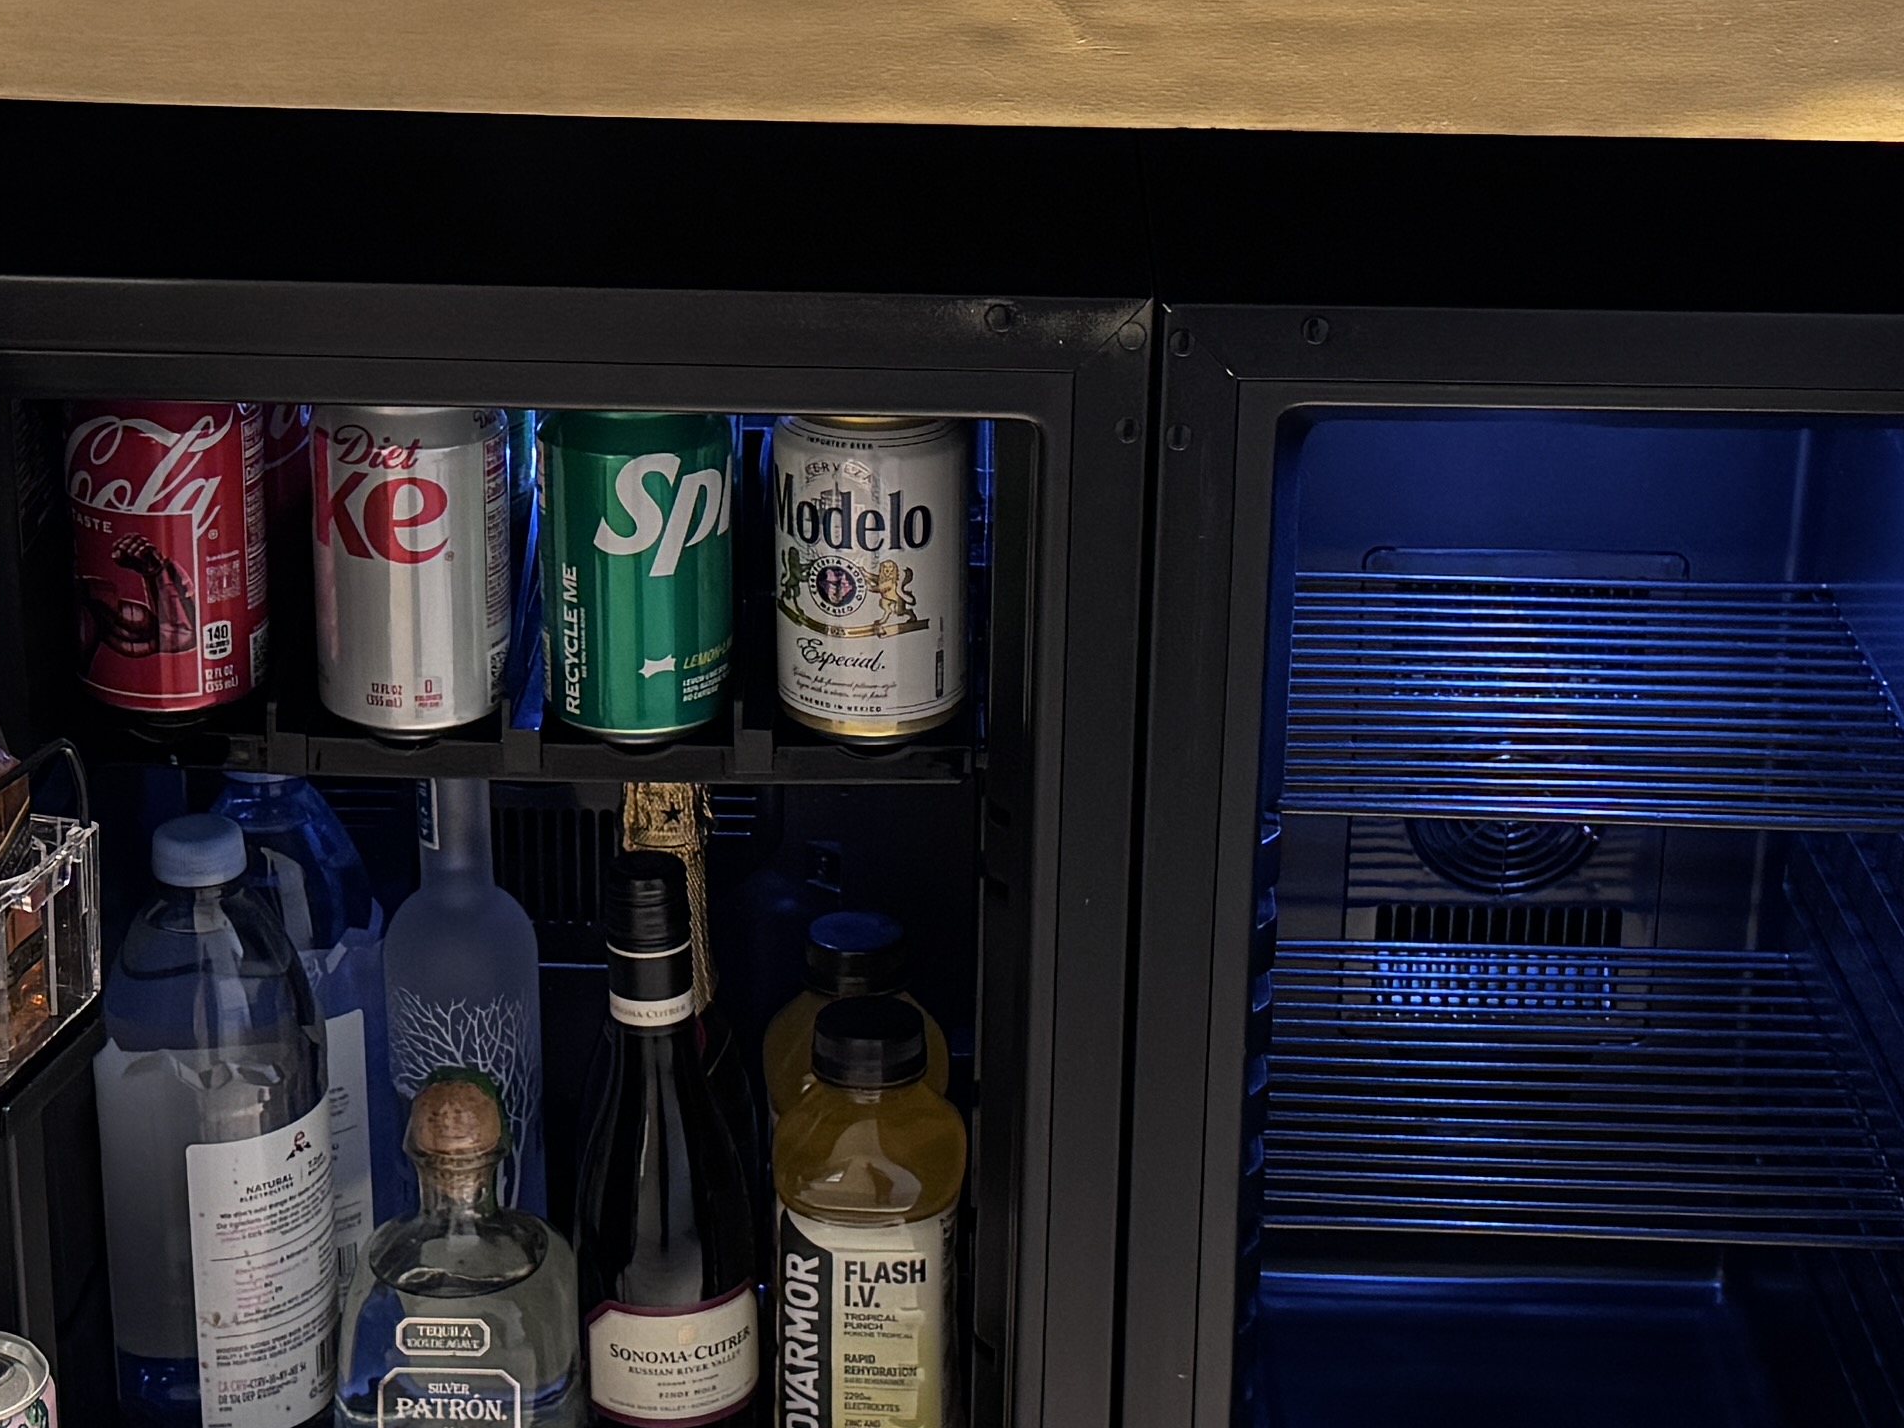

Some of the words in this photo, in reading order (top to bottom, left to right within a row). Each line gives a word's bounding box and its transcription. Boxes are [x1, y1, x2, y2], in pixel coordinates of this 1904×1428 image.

[334, 424, 422, 470] Diet
[775, 464, 933, 552] Modelo
[562, 562, 578, 604] ME
[207, 624, 229, 642] 140
[564, 605, 581, 715] RECYCLE
[246, 1173, 294, 1194] NATURAL
[844, 1259, 926, 1283] FLASH
[844, 1285, 881, 1308] I.V.
[844, 1313, 899, 1323] TROPICAL
[844, 1322, 883, 1331] PUNCH
[844, 1354, 876, 1363] RAPID
[628, 1365, 673, 1376] RUSSIAN
[677, 1363, 709, 1375] RIVER
[844, 1365, 918, 1377] REHYDRATION
[427, 1383, 470, 1395] SILVER
